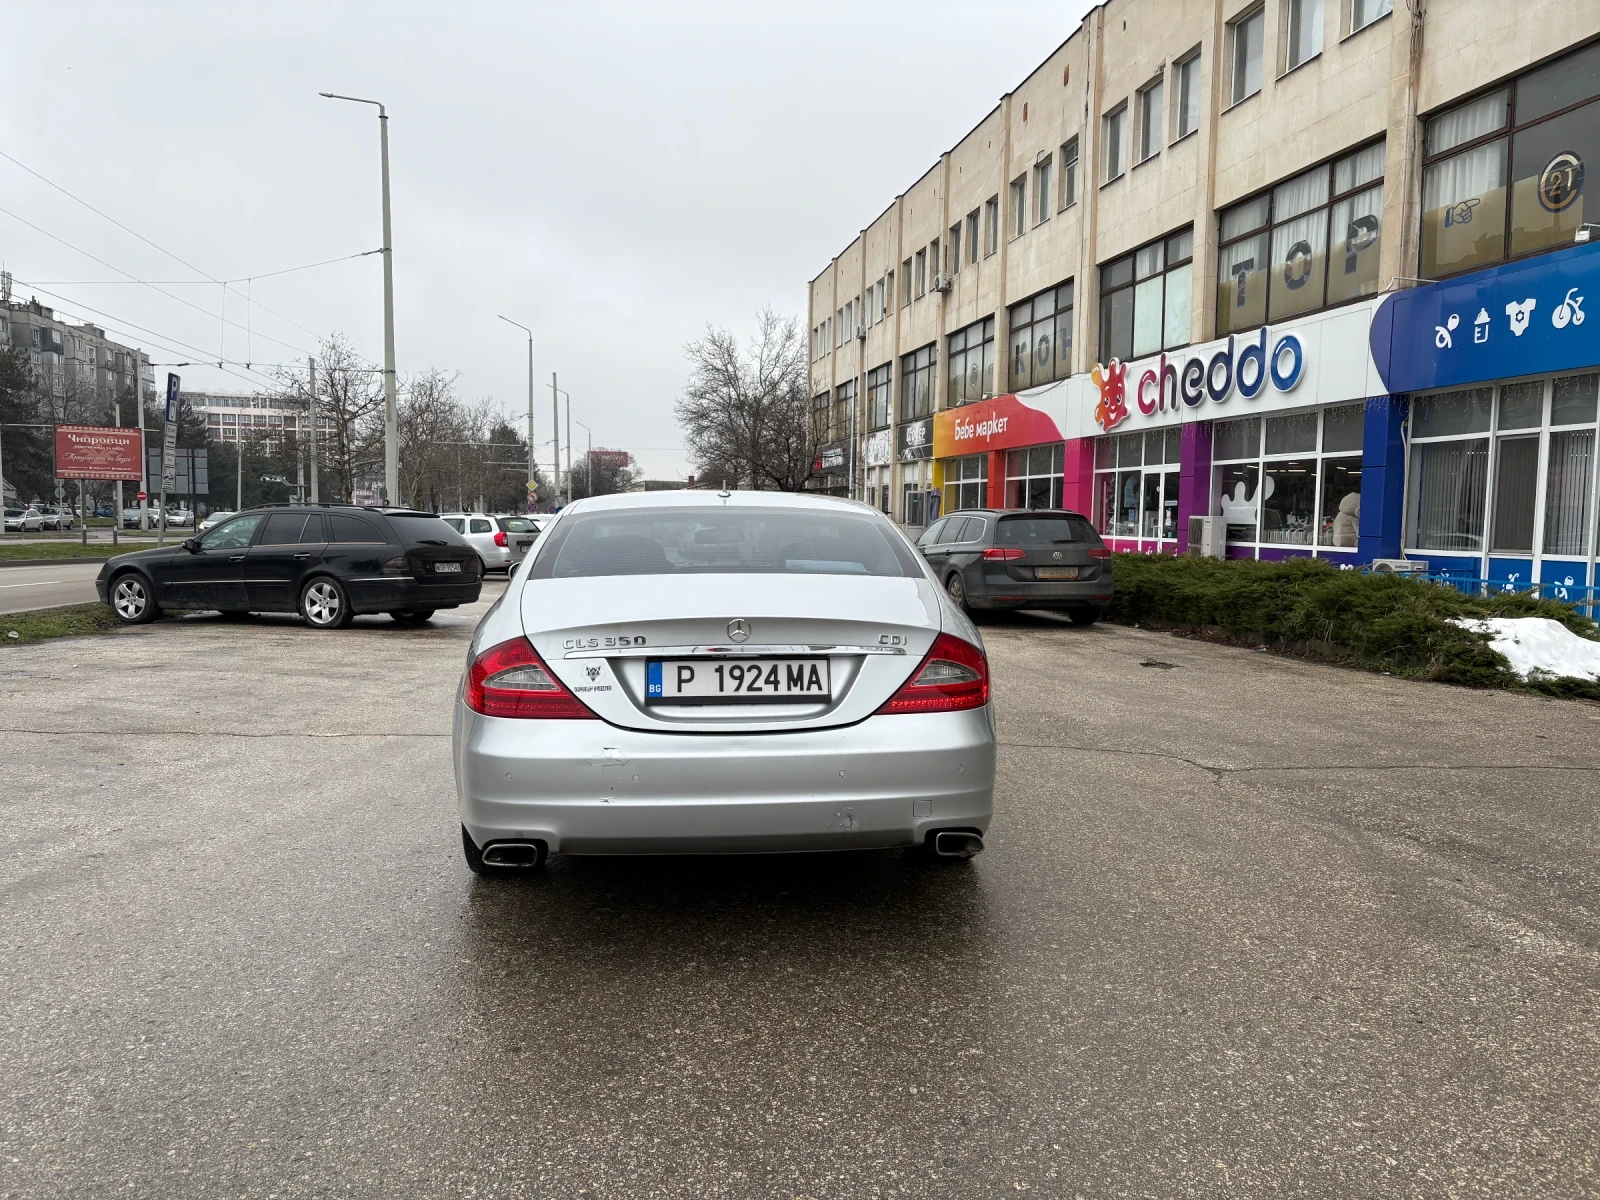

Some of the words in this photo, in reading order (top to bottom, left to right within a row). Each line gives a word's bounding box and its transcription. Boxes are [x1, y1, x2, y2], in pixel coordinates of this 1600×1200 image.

[1137, 325, 1305, 416] cheddo
[171, 376, 178, 398] P
[954, 416, 974, 441] Бебе
[975, 411, 1009, 443] маркет
[67, 434, 130, 446] Чипровци
[563, 637, 599, 650] CLS
[604, 635, 647, 647] 350
[878, 634, 908, 646] CDI
[677, 665, 695, 692] P
[714, 664, 780, 693] 1924
[786, 663, 823, 692] MA
[649, 684, 661, 693] BG
